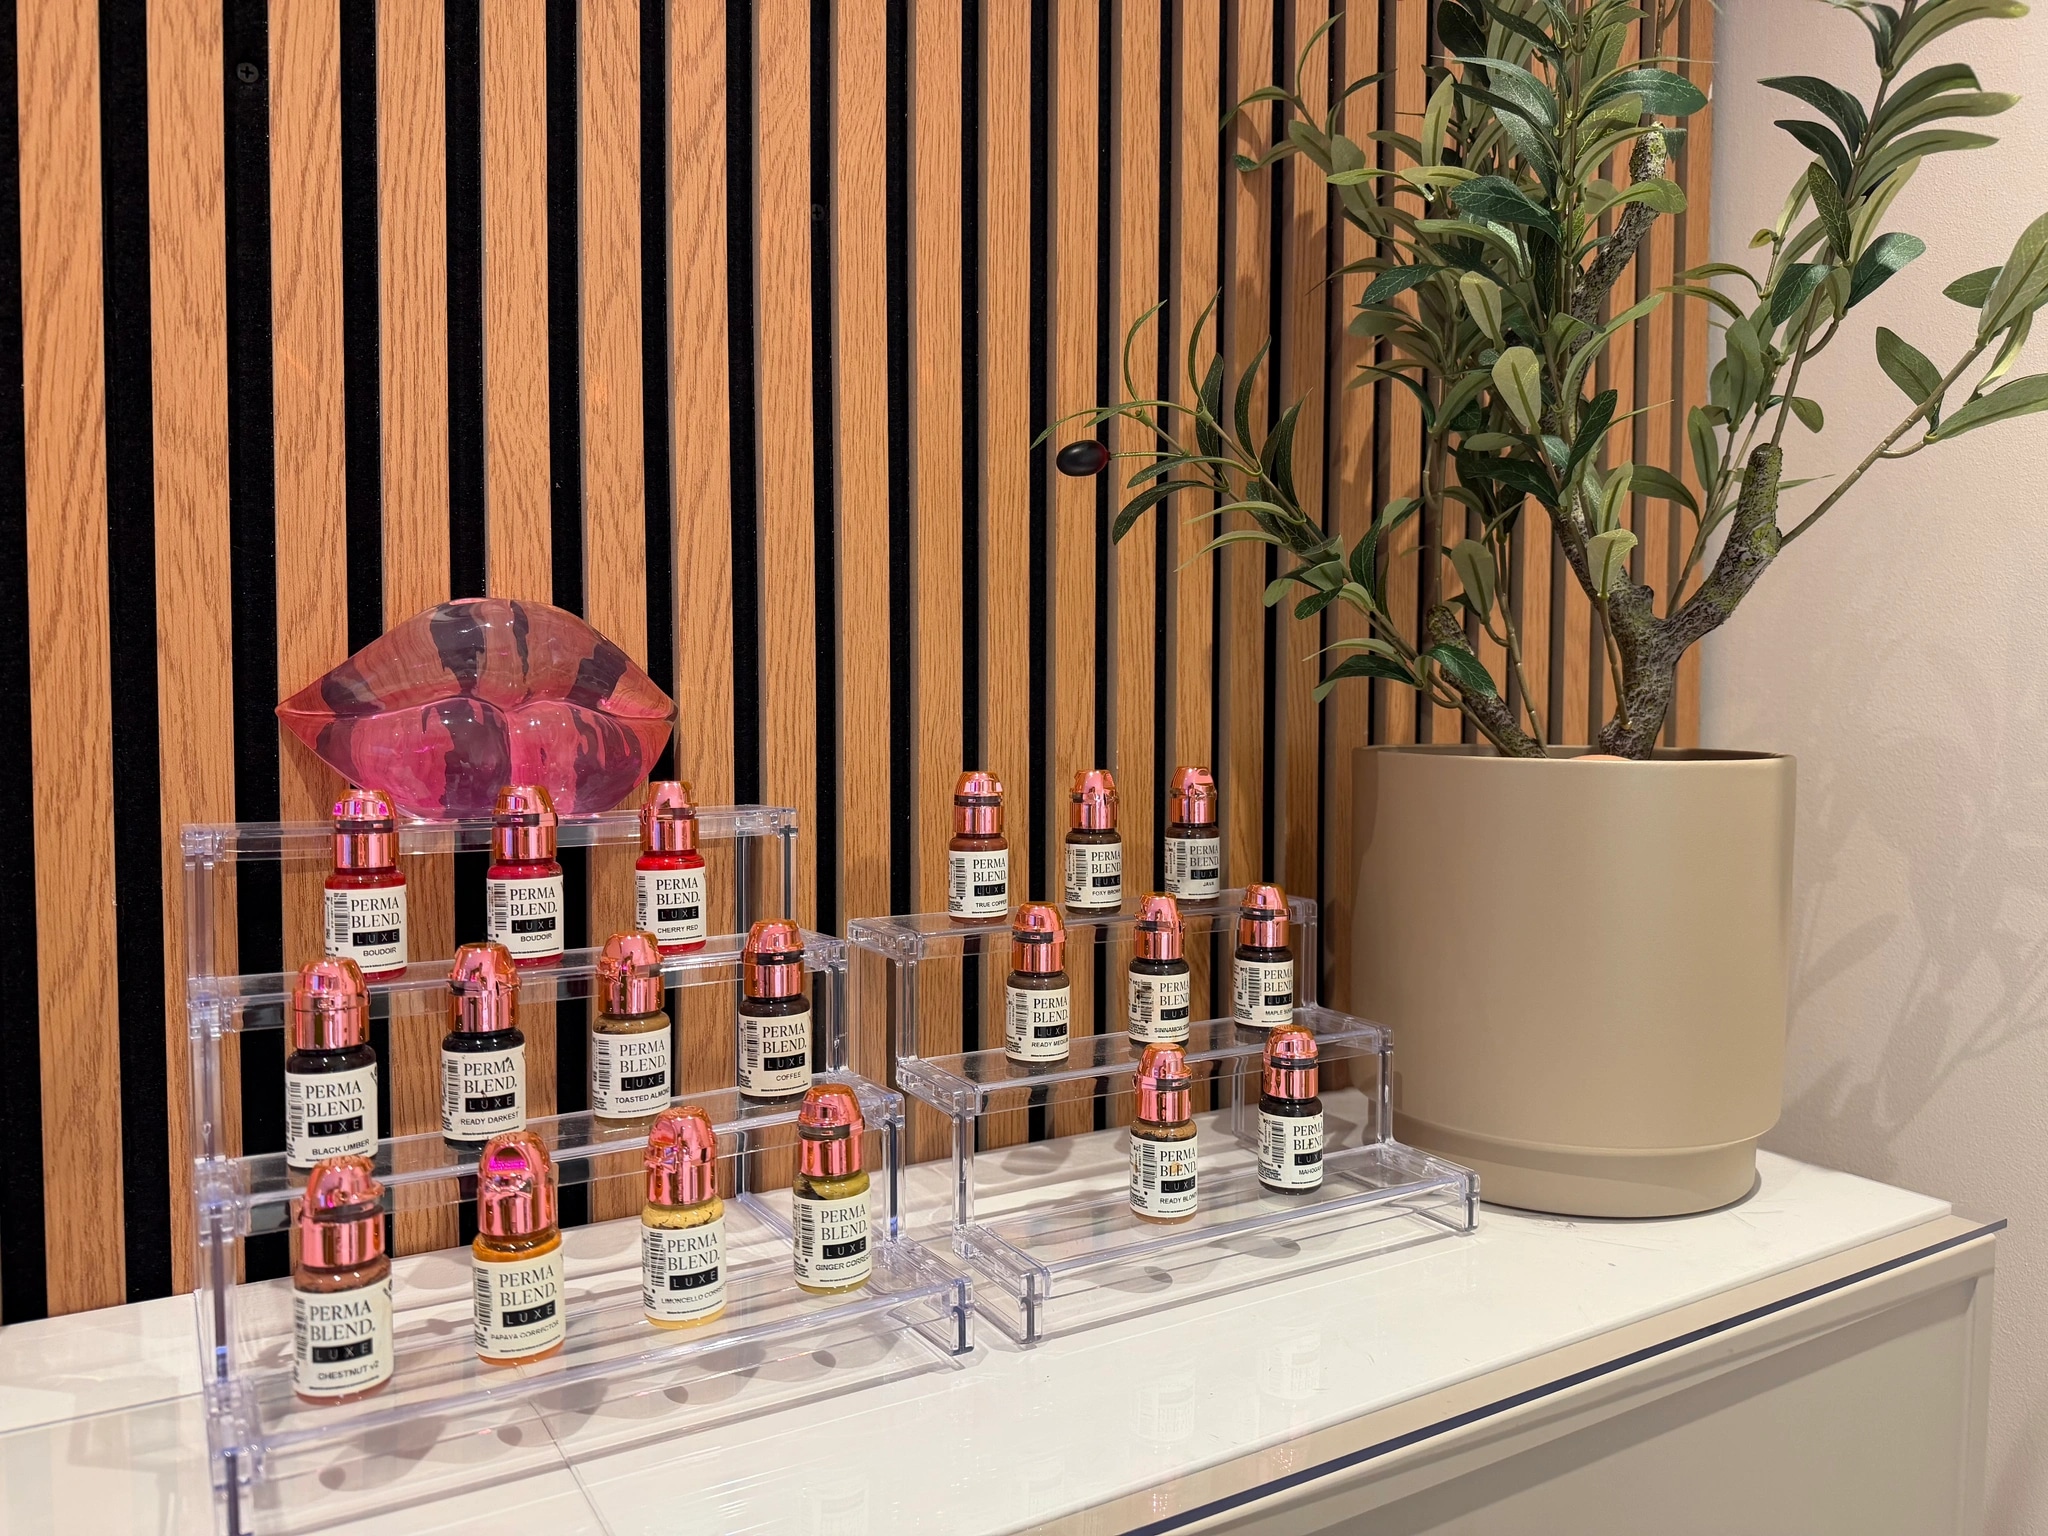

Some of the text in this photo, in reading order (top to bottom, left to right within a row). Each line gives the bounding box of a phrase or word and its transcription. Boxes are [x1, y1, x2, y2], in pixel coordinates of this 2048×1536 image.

[973, 858, 1005, 869] PERMA
[656, 877, 698, 890] PERMA
[978, 885, 1004, 894] LUXE
[510, 886, 555, 900] PERMA
[351, 897, 399, 912] PERMA
[662, 909, 696, 919] LUXE
[516, 920, 554, 931] LUXE
[357, 932, 397, 944] LUXE
[521, 933, 552, 942] BOUDOIR
[363, 947, 396, 956] BOUDOIR
[1034, 996, 1067, 1009] PERMA
[763, 1023, 805, 1038] PERMA
[1038, 1026, 1066, 1036] LUXE
[620, 1040, 665, 1056] PERMA
[464, 1059, 514, 1076] PERMA
[768, 1056, 803, 1068] LUXE
[625, 1074, 662, 1088] LUXE
[776, 1072, 801, 1081] COFFEE
[306, 1080, 361, 1099] PERMA
[469, 1096, 512, 1109] LUXE
[615, 1094, 649, 1103] TOASTED
[488, 1112, 519, 1123] DARKEST
[312, 1120, 359, 1134] LUXE
[312, 1139, 369, 1155] BLACK UMBER
[1160, 1147, 1195, 1161] PERMA
[1165, 1179, 1194, 1190] LUXE
[821, 1204, 866, 1223] PERMA
[667, 1232, 717, 1253] PERMA
[827, 1240, 864, 1256] LUXE
[499, 1264, 554, 1288] PERMA
[674, 1271, 716, 1287] LUXE
[661, 1295, 703, 1304] LIMONCELLO
[310, 1300, 371, 1321] PERMA
[506, 1305, 552, 1324] LUXE
[520, 1320, 559, 1339] CORRECTOR
[316, 1342, 369, 1360] LUXE
[318, 1365, 368, 1380] CHESTNUT
